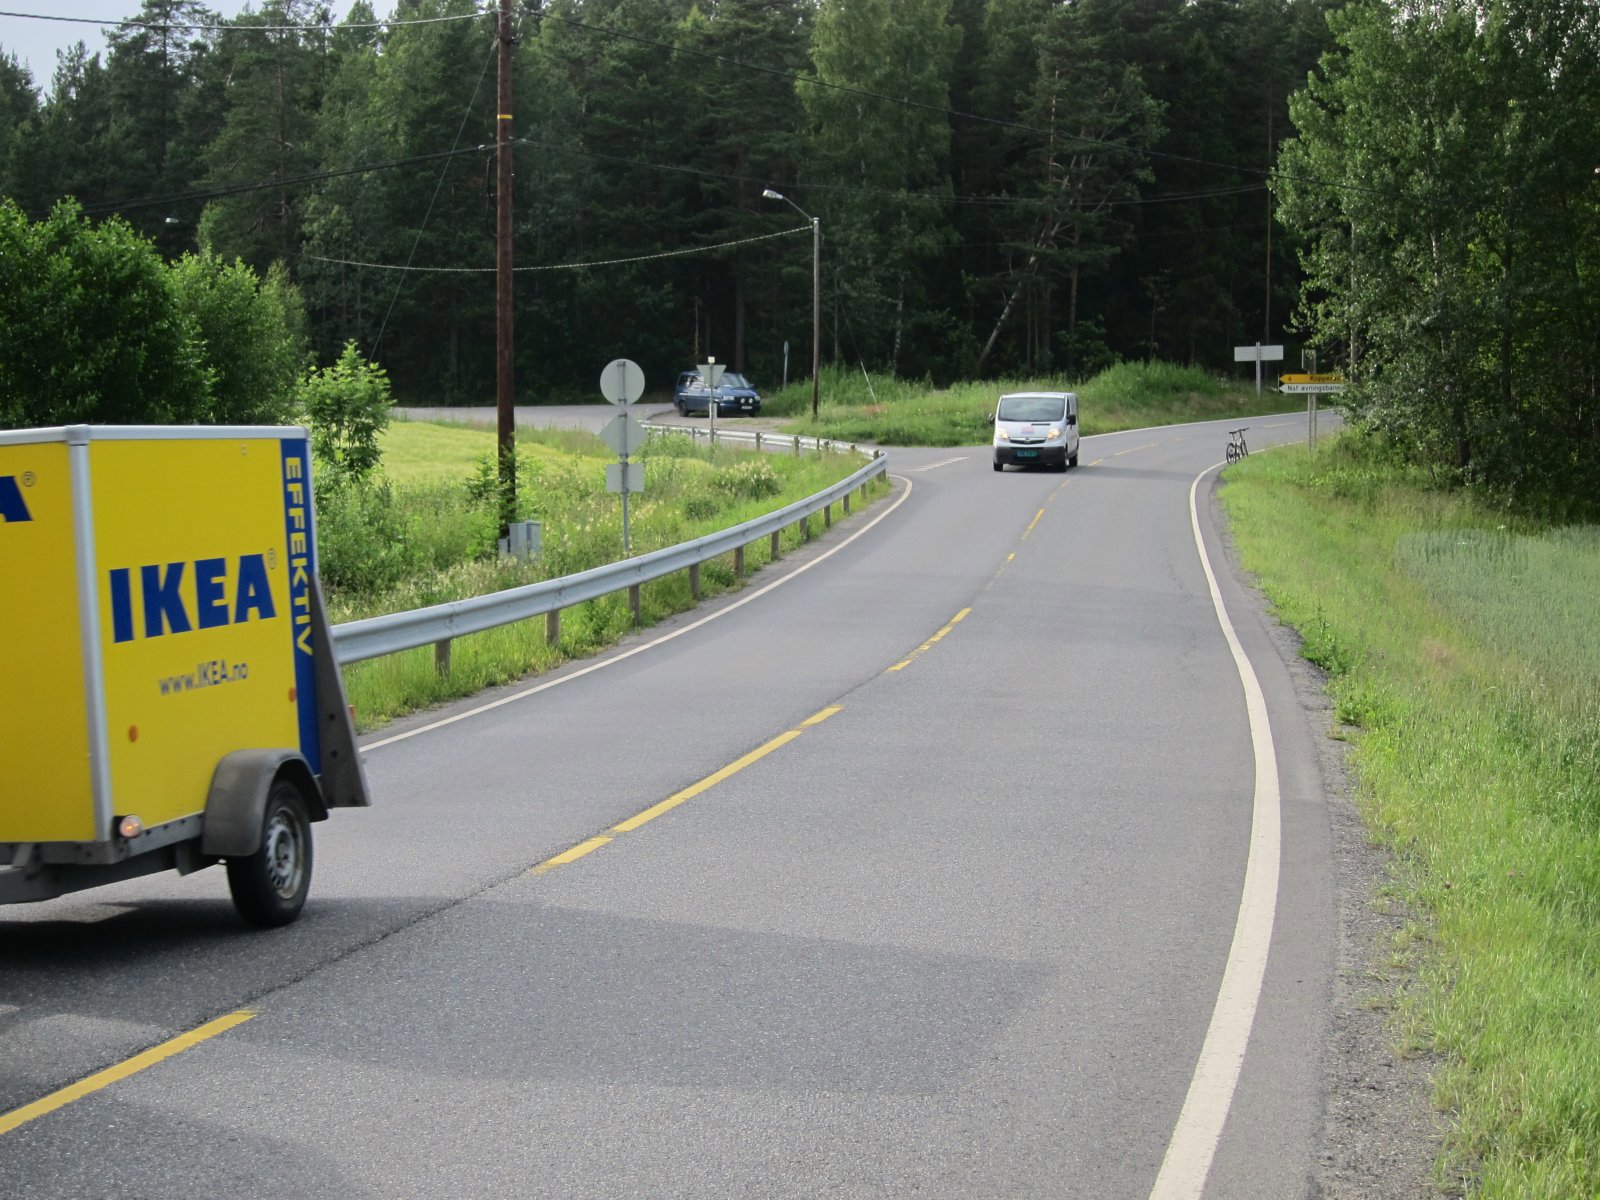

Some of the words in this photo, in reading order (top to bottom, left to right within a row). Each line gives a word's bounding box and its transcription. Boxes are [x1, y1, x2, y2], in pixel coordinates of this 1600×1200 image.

[109, 553, 277, 644] IKEA
[285, 456, 314, 656] EFFEKTIV
[158, 660, 249, 696] www.IKEA.no
